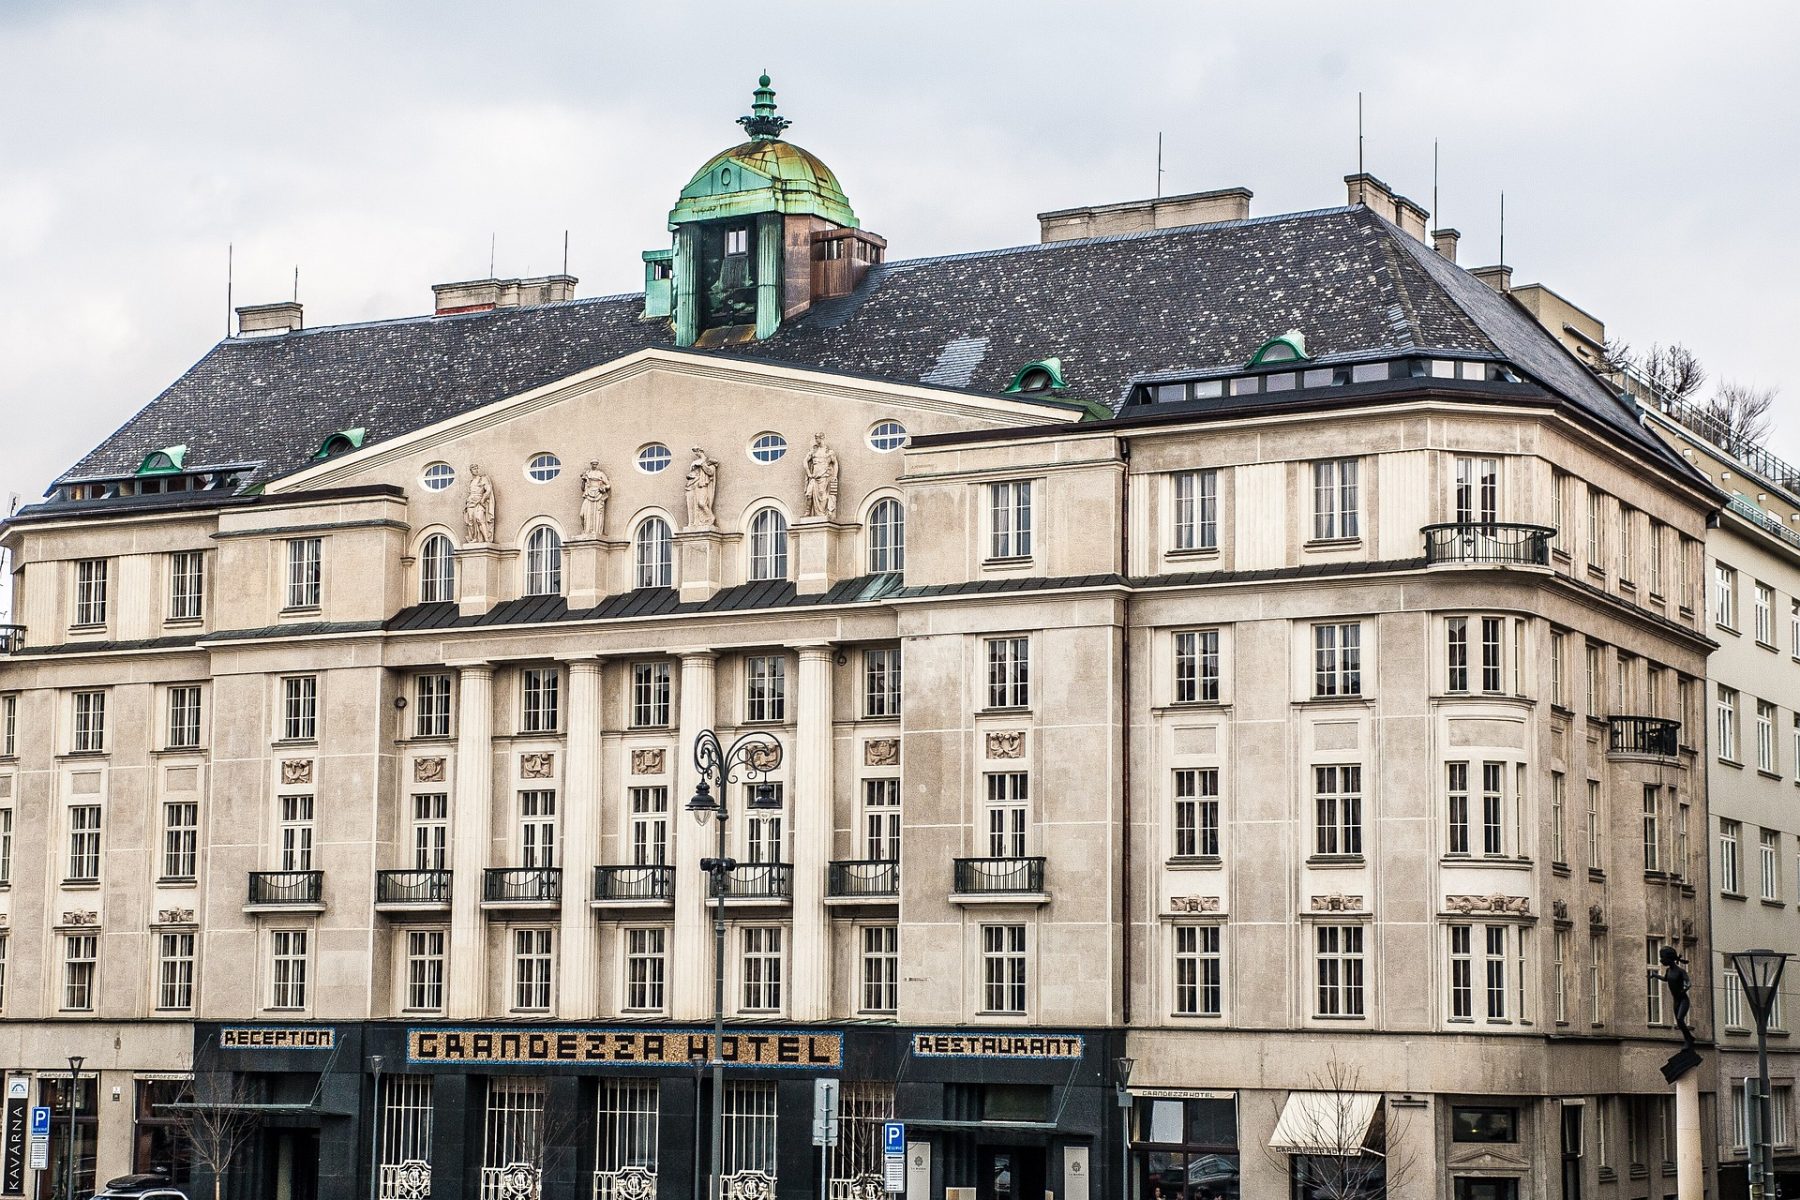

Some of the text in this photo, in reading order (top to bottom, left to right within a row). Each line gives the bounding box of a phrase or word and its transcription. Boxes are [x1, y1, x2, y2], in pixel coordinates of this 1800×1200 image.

[224, 1030, 331, 1046] RECEPTION
[919, 1036, 1077, 1056] RESTAURANT
[418, 1033, 831, 1063] GRANDEZZA HOTEL
[35, 1110, 46, 1127] P
[889, 1127, 900, 1145] P
[8, 1106, 23, 1190] KAVÁRNA
